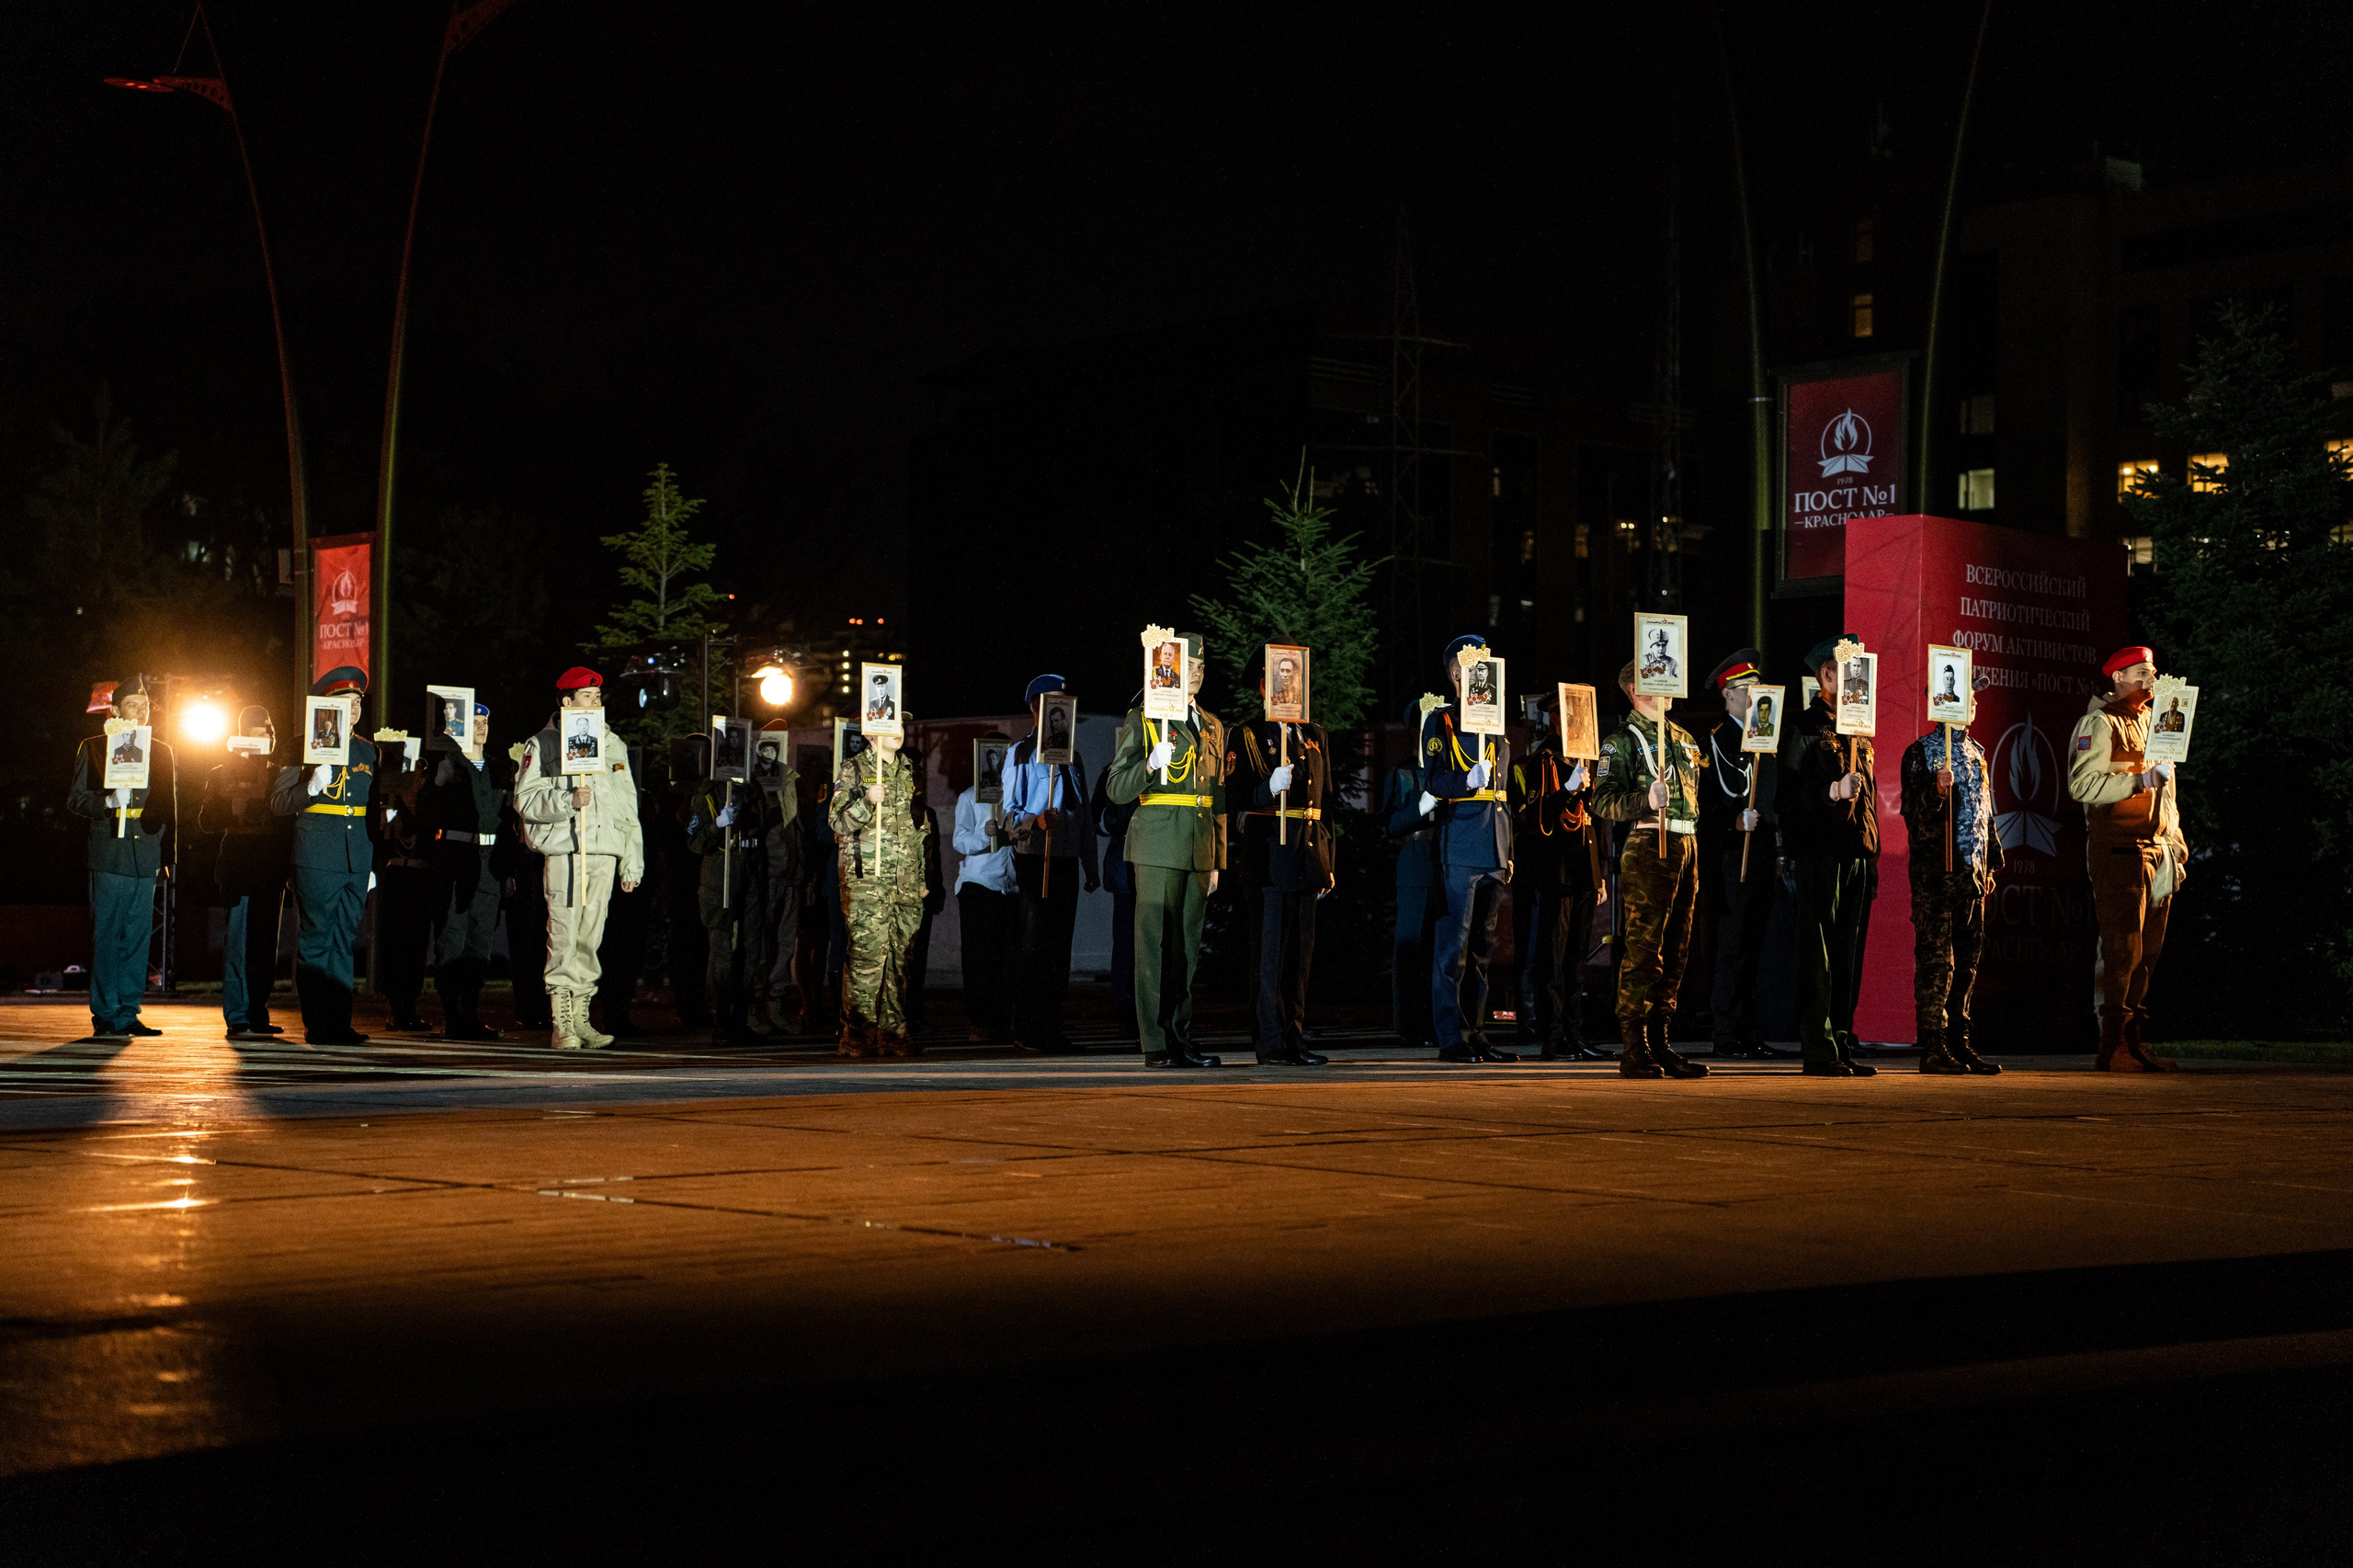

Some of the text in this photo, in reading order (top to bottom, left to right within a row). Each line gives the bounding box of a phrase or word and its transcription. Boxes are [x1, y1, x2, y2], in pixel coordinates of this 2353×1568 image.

[1836, 476, 1854, 485] 1978
[1794, 483, 1896, 513] ПОСТ №1
[1966, 563, 2086, 597] ВСЕРОССИЙСКИЙ
[1961, 597, 2090, 631] ПАТРИОТИЧЕСКИЙ
[320, 623, 351, 640] ПОСТ
[1953, 630, 2097, 665] ФОРУМ АКТИВИСТОВ
[2013, 859, 2036, 874] 1978
